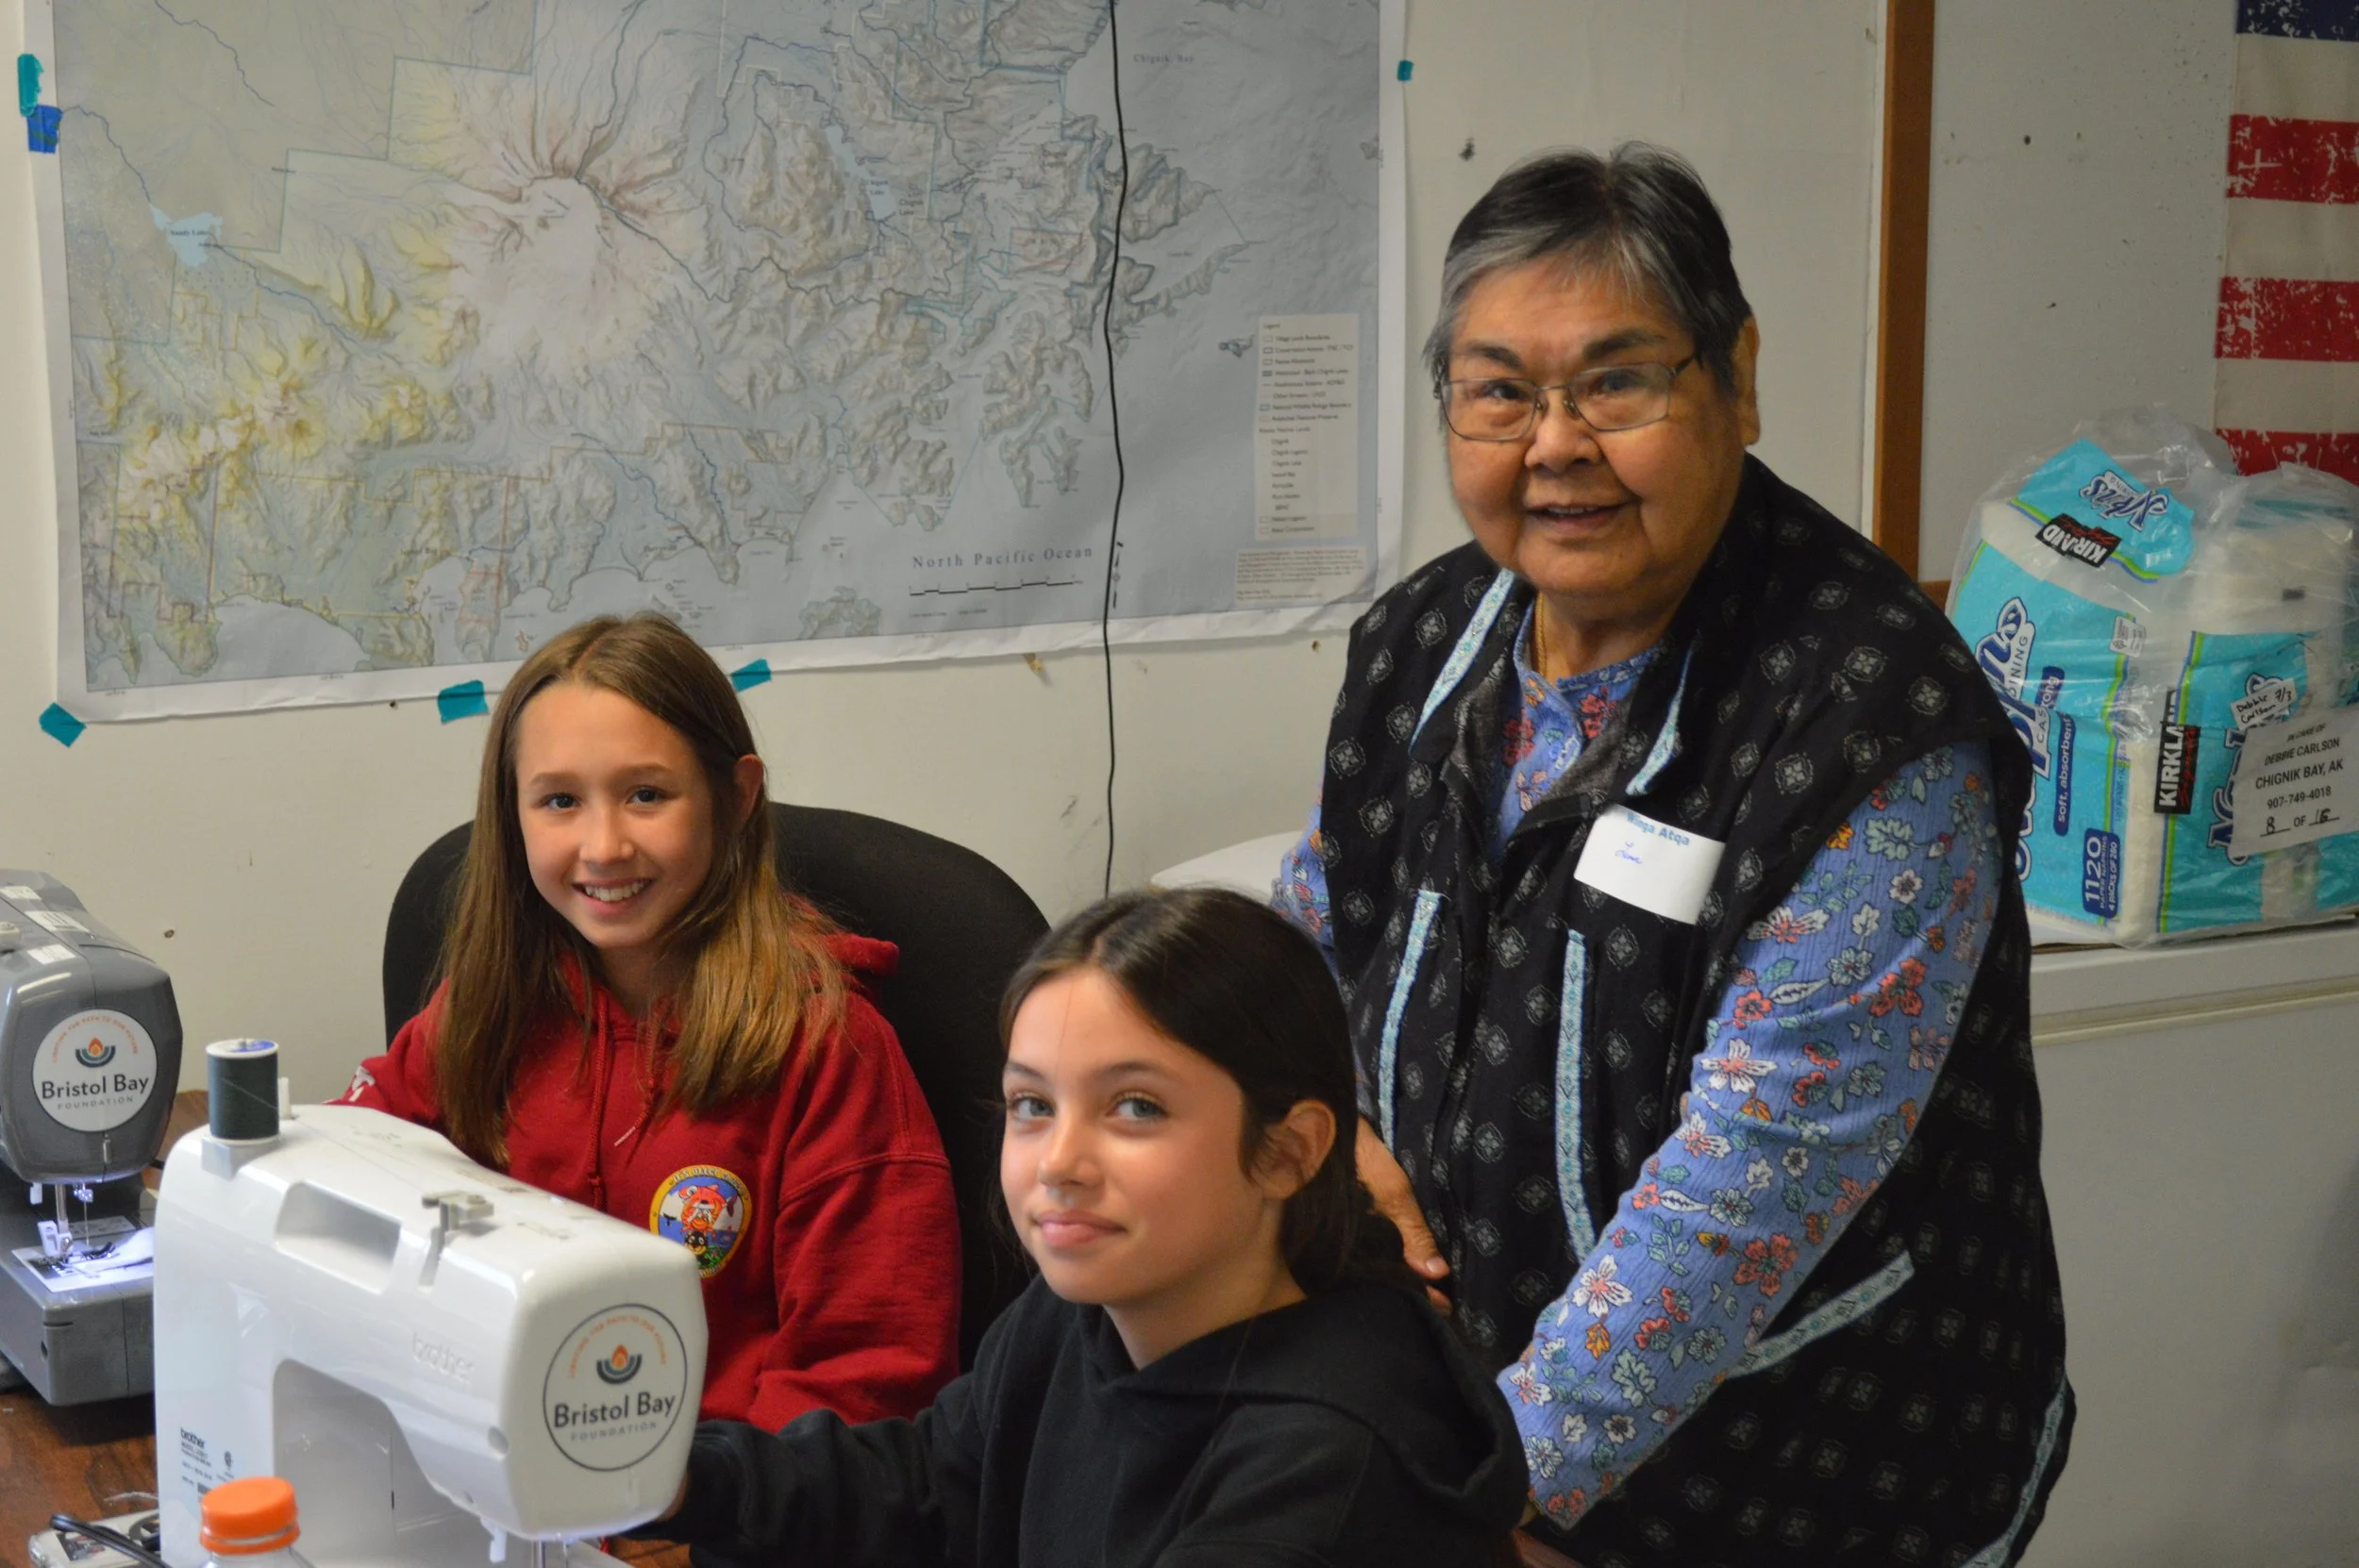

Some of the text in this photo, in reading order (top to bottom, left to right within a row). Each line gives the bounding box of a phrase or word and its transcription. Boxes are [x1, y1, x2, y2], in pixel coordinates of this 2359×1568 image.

[1133, 54, 1194, 64] Chignik Bay
[913, 547, 1092, 568] North Pacific Ocean
[2316, 723, 2327, 733] OF
[2060, 717, 2072, 789] absorbent
[2265, 737, 2340, 766] DEBBIE CARLSON
[2255, 759, 2344, 790] CHIGNIK BAY, AK
[2058, 792, 2068, 823] soft,
[2267, 785, 2332, 809] 907-749-4018
[2293, 815, 2307, 828] OF
[1659, 827, 1690, 846] Atqa
[2085, 836, 2101, 902] 1120
[2108, 841, 2118, 911] 4 PACKS OF 280
[42, 1073, 149, 1100] Bristol Bay
[57, 1095, 134, 1110] FOUNDATION
[411, 1331, 474, 1383] brother
[554, 1392, 676, 1428] Bristol Bay
[180, 1426, 206, 1450] brother
[571, 1421, 657, 1442] FOUNDATION
